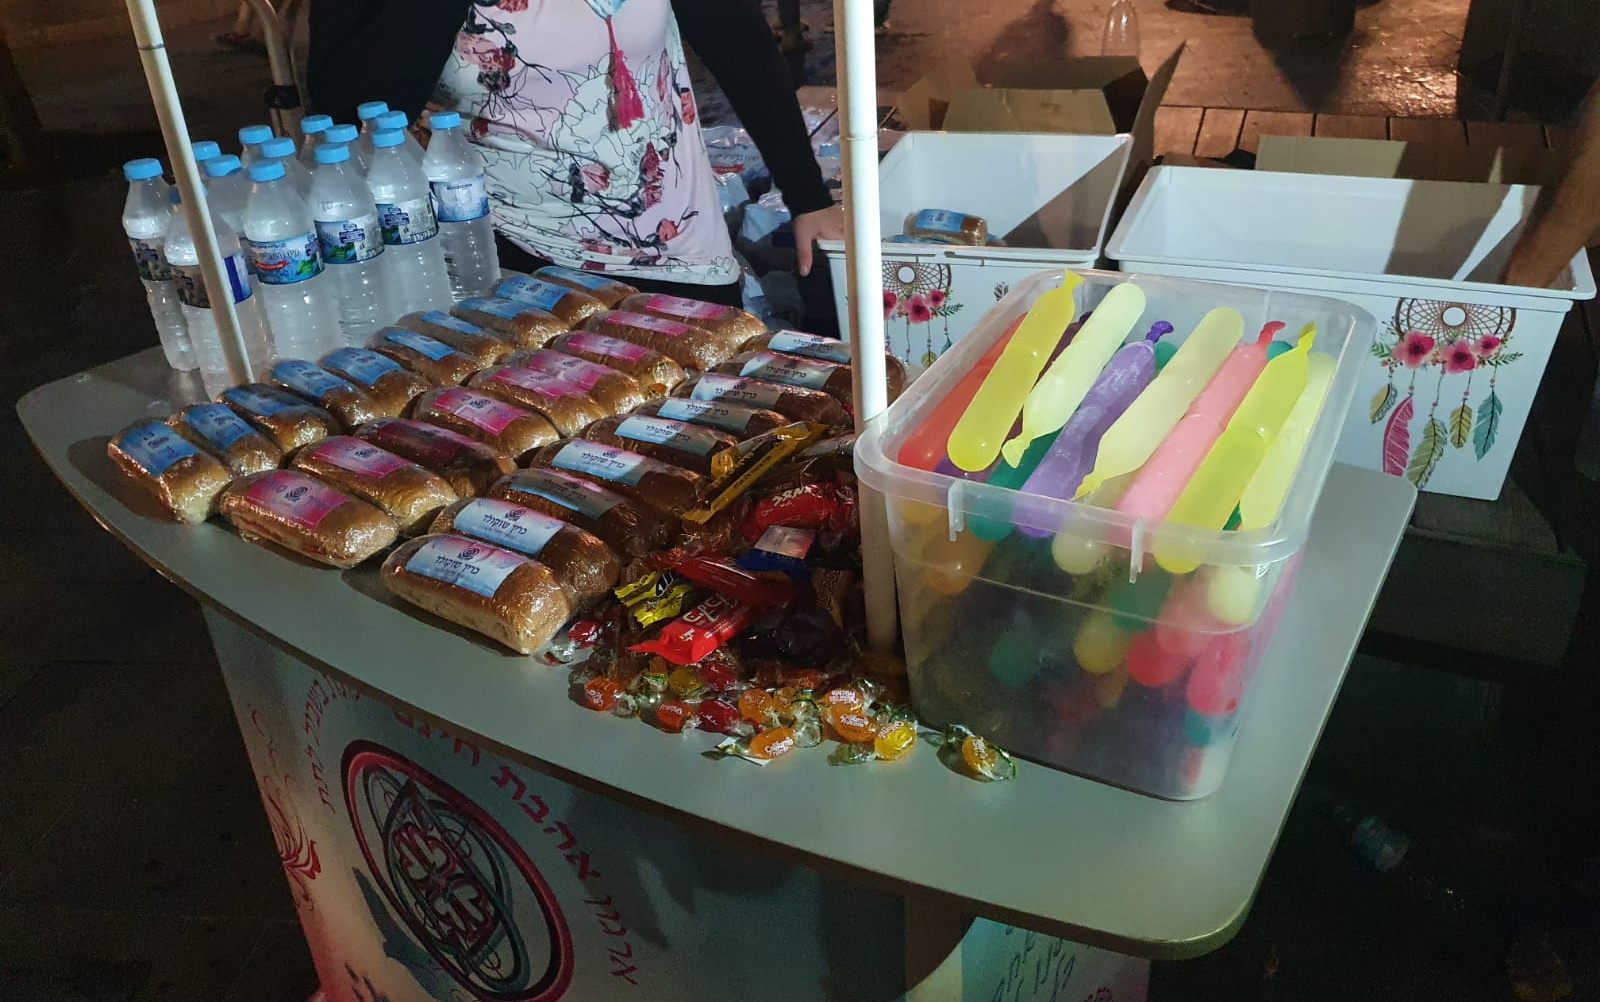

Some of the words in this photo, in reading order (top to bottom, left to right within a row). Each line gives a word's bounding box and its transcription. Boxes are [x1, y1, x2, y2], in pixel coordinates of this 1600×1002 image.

[581, 451, 608, 465] שוקולד
[608, 457, 626, 469] כריך
[482, 512, 512, 531] שוקולד
[512, 523, 528, 536] כריך
[435, 554, 464, 572] שוקולד
[464, 563, 480, 576] כריך
[490, 764, 601, 882] אהבת
[584, 893, 640, 986] ארגון
